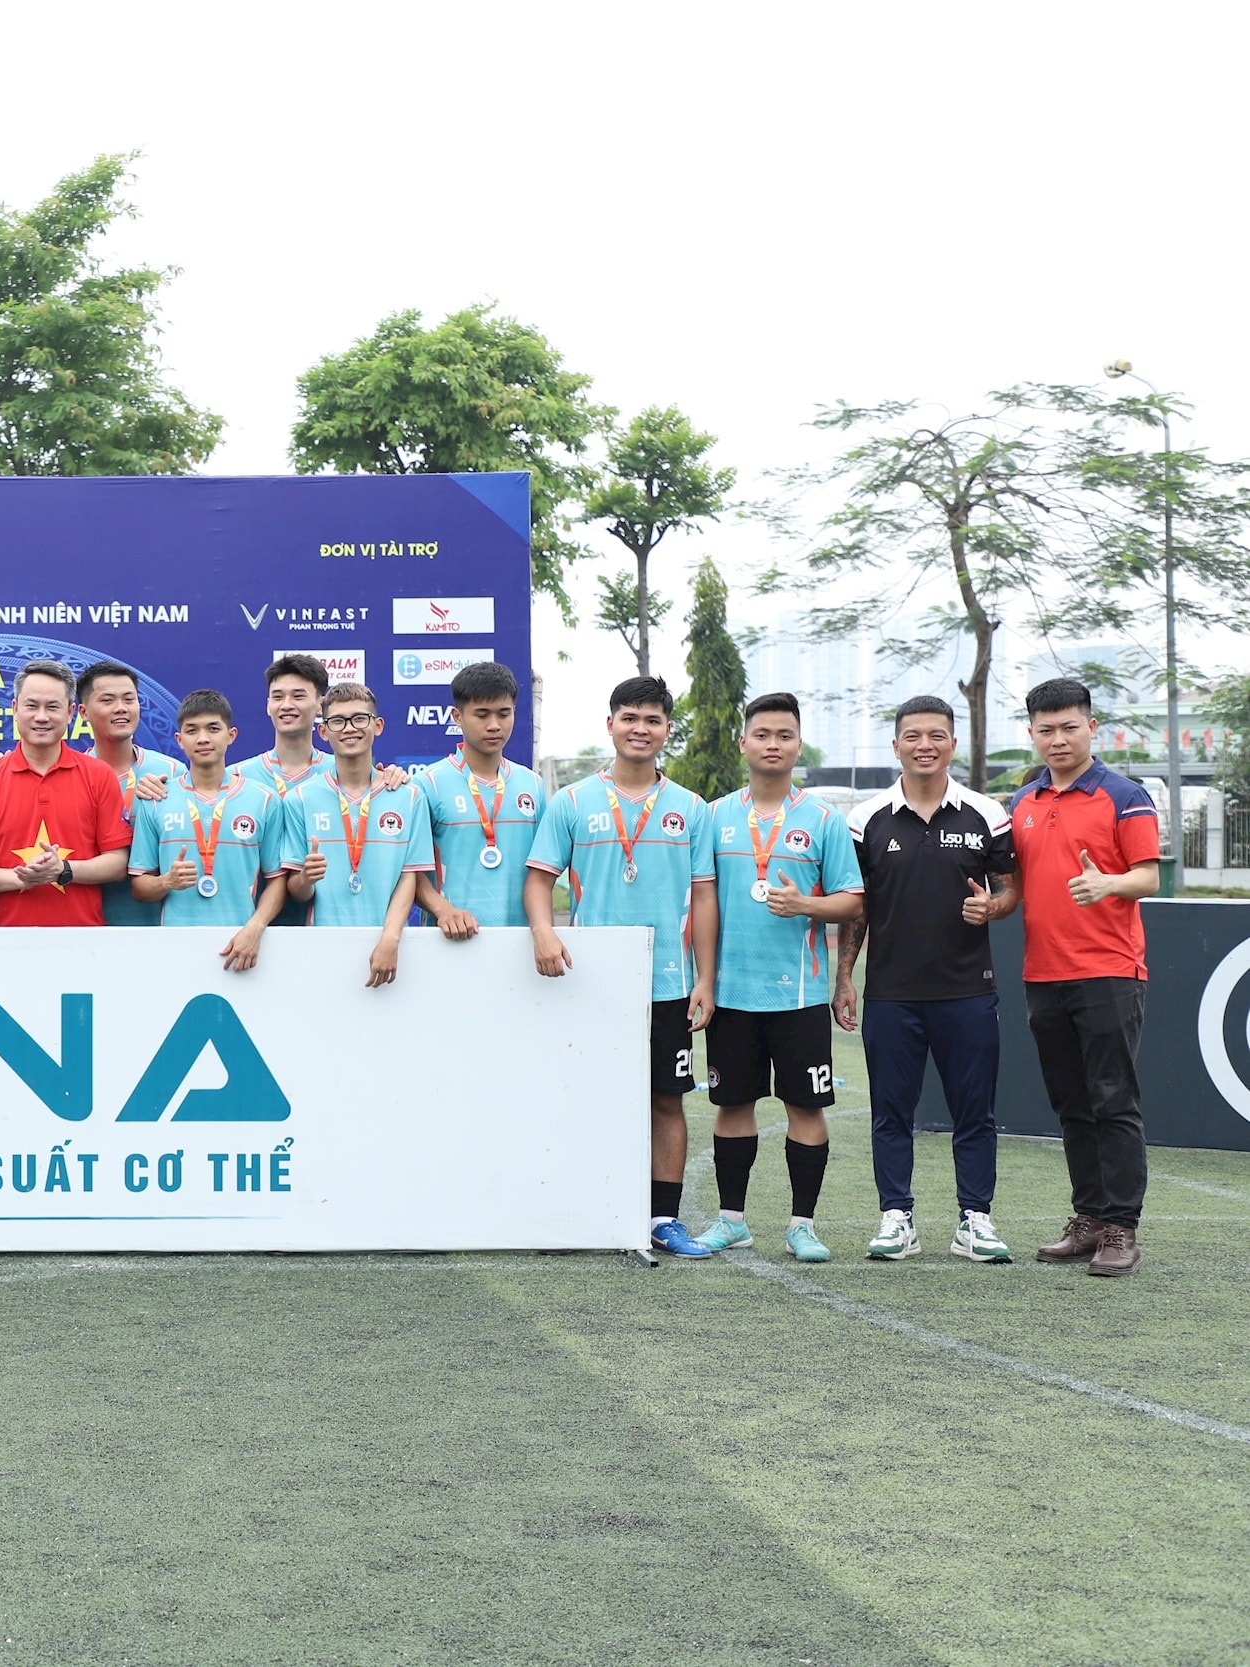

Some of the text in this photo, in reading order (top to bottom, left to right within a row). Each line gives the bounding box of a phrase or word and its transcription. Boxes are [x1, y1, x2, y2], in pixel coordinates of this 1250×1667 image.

[320, 540, 439, 559] ĐƠN VỊ TÀI TRỢ
[33, 601, 82, 624] NIÊN
[88, 601, 132, 628] VIỆT
[138, 605, 189, 623] NAM
[275, 607, 369, 621] VINFAST
[312, 623, 339, 632] TRỌNG
[340, 621, 355, 631] TUỆ
[425, 622, 460, 632] KAMITO
[320, 658, 358, 669] BALM
[407, 706, 456, 725] NEV
[454, 795, 468, 813] 9
[164, 813, 185, 831] 24
[313, 813, 330, 831] 15
[588, 812, 611, 833] 20
[720, 826, 736, 844] 12
[807, 1064, 831, 1095] 12
[124, 1150, 185, 1193] CƠ
[207, 1137, 295, 1192] THỂ
